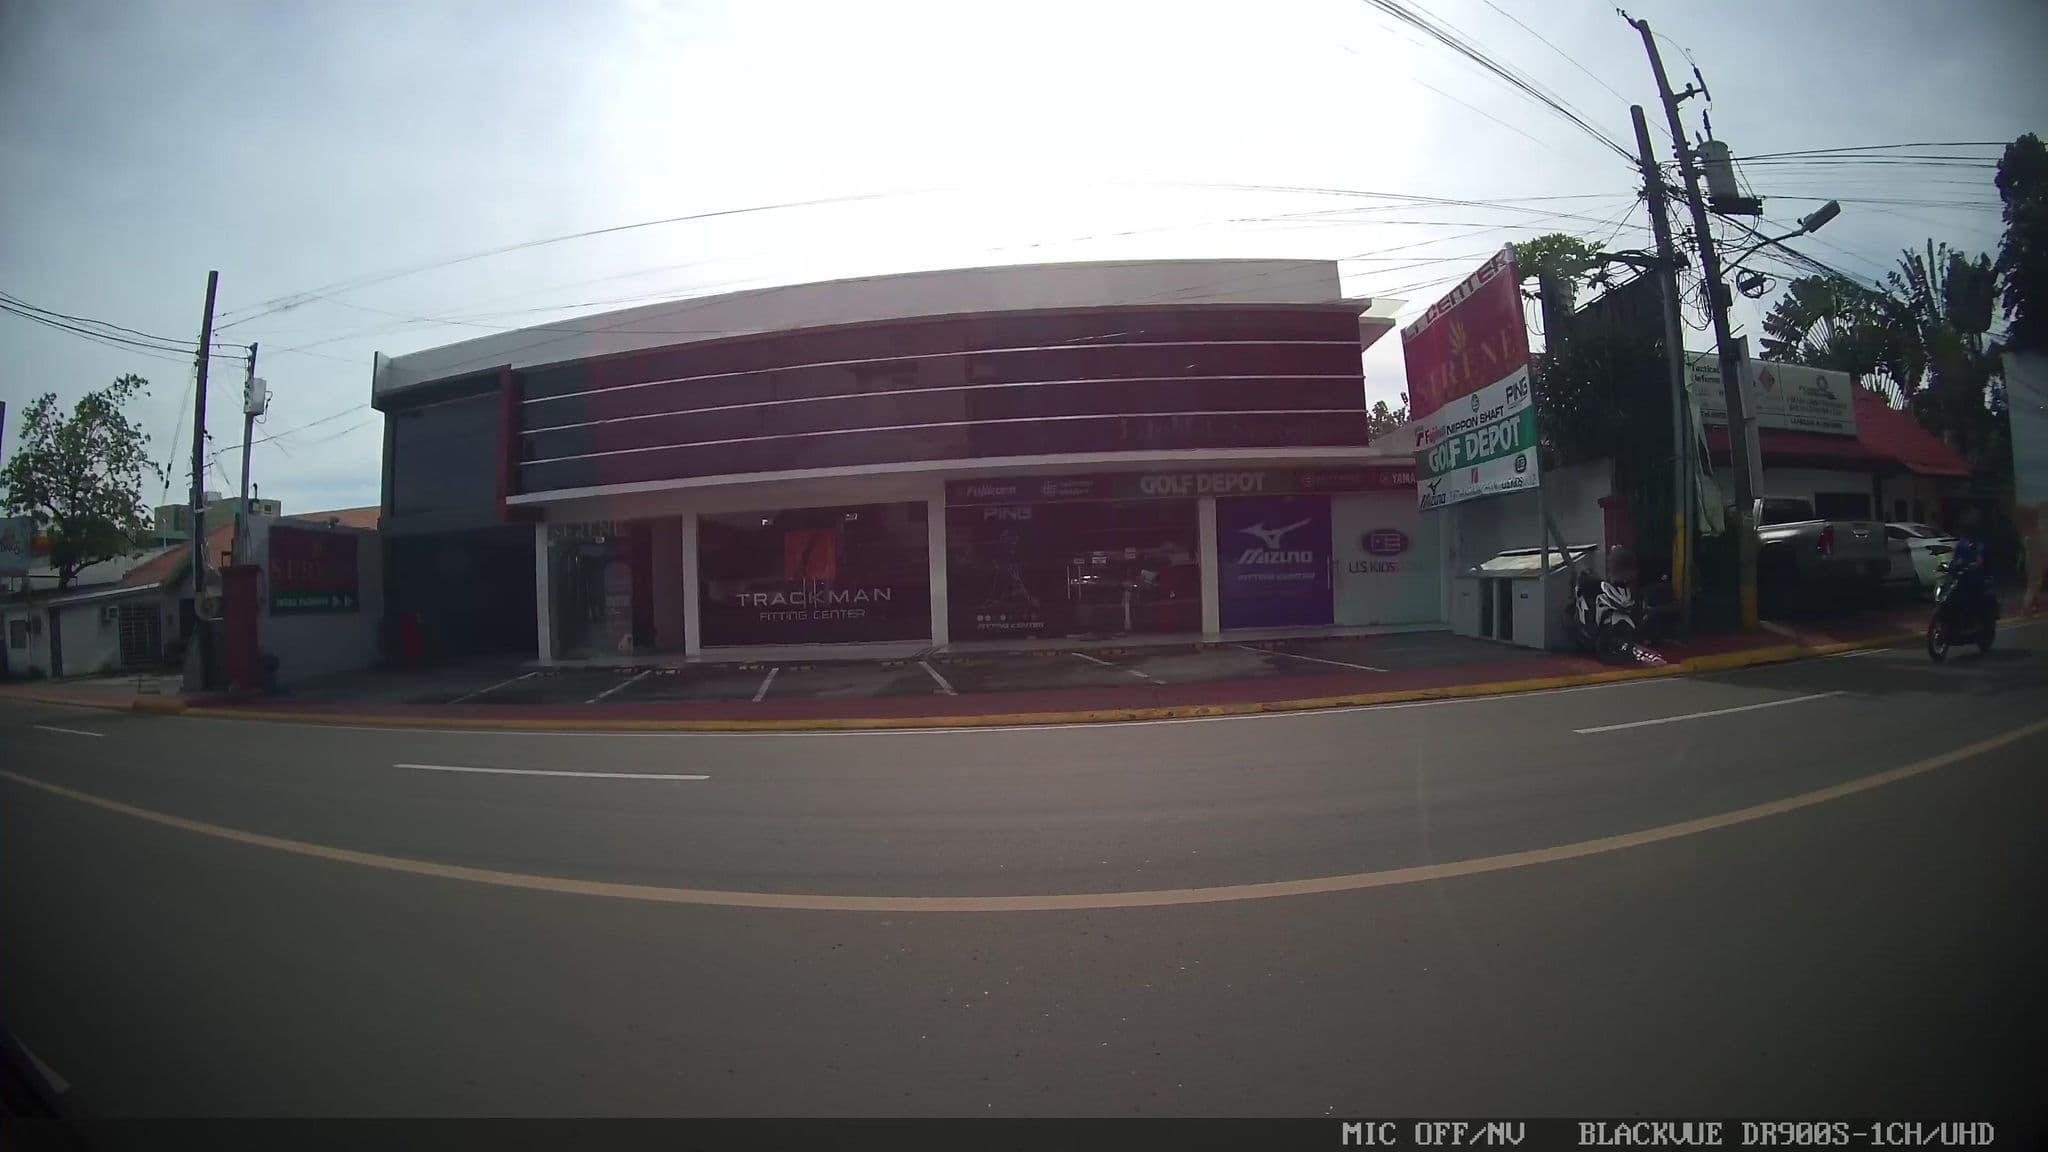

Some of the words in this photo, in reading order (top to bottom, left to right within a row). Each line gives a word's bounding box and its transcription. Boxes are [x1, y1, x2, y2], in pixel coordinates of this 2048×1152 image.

[1505, 376, 1528, 404] PING
[1446, 414, 1478, 435] NIPPON
[1480, 405, 1504, 424] SHAFT
[1428, 437, 1461, 472] GOLF
[1465, 416, 1521, 461] DEPOT
[1140, 474, 1194, 494] GOLF
[1197, 471, 1270, 492] DEPOT
[983, 508, 1033, 521] PING
[736, 587, 892, 607] TRACKMAN
[760, 610, 808, 622] FITTING
[812, 608, 867, 621] CENTER
